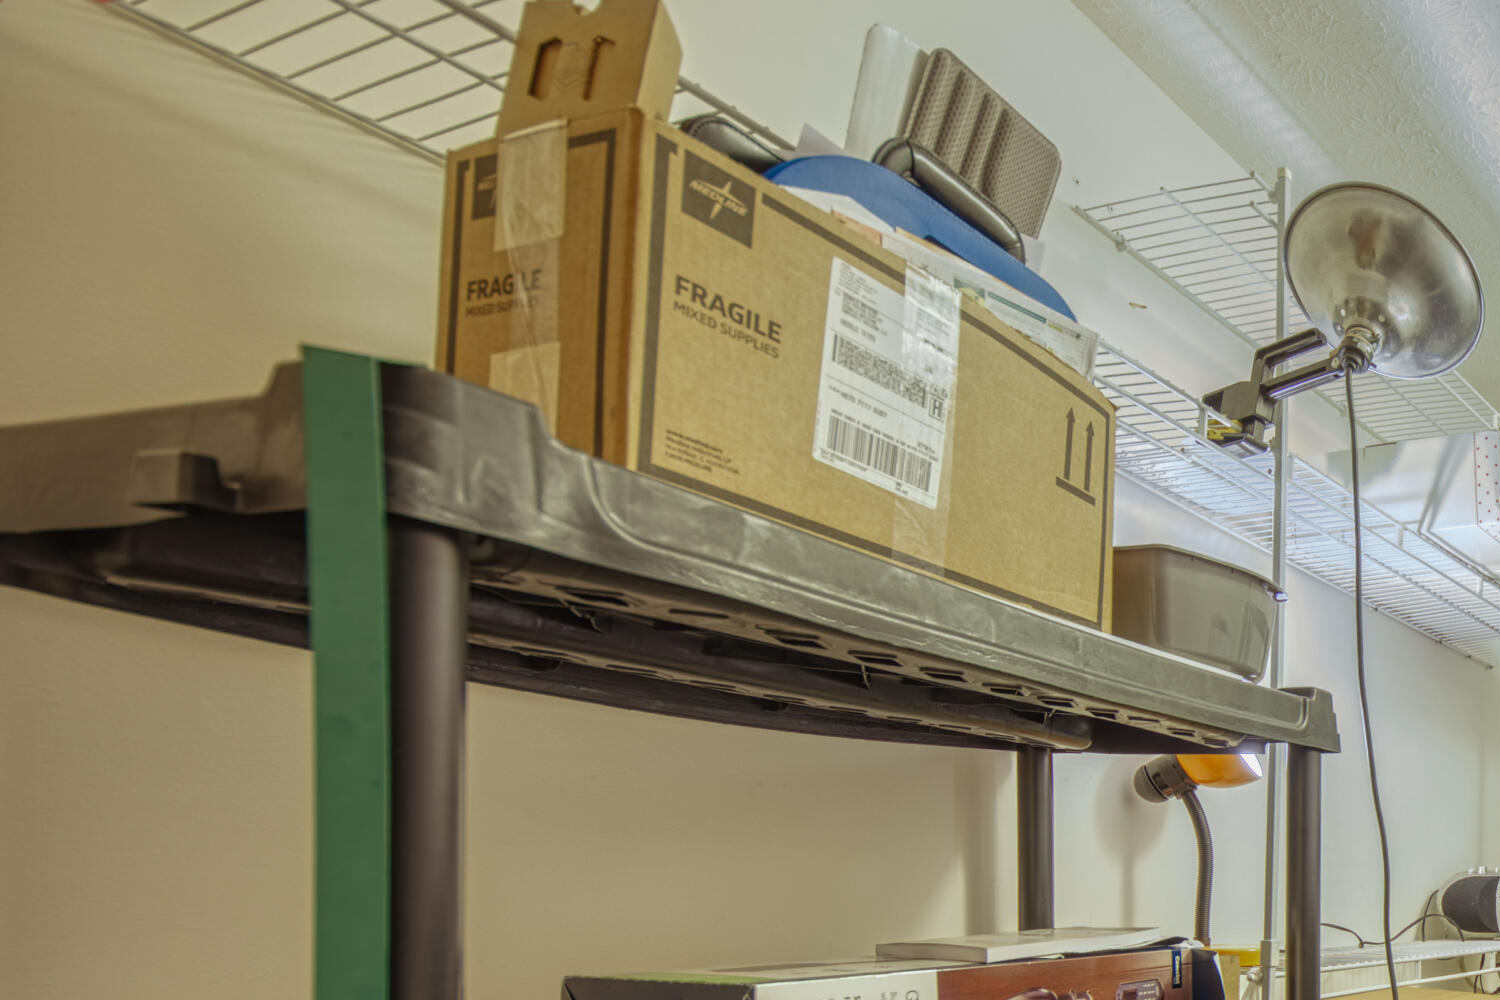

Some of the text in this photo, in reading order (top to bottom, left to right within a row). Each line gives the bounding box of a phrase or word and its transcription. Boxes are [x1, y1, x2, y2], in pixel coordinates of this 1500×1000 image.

[689, 180, 748, 217] MEDLINE
[467, 269, 542, 302] FRAGLE
[675, 274, 782, 344] FRAGILE
[673, 300, 780, 359] MIXED SUPPLIES
